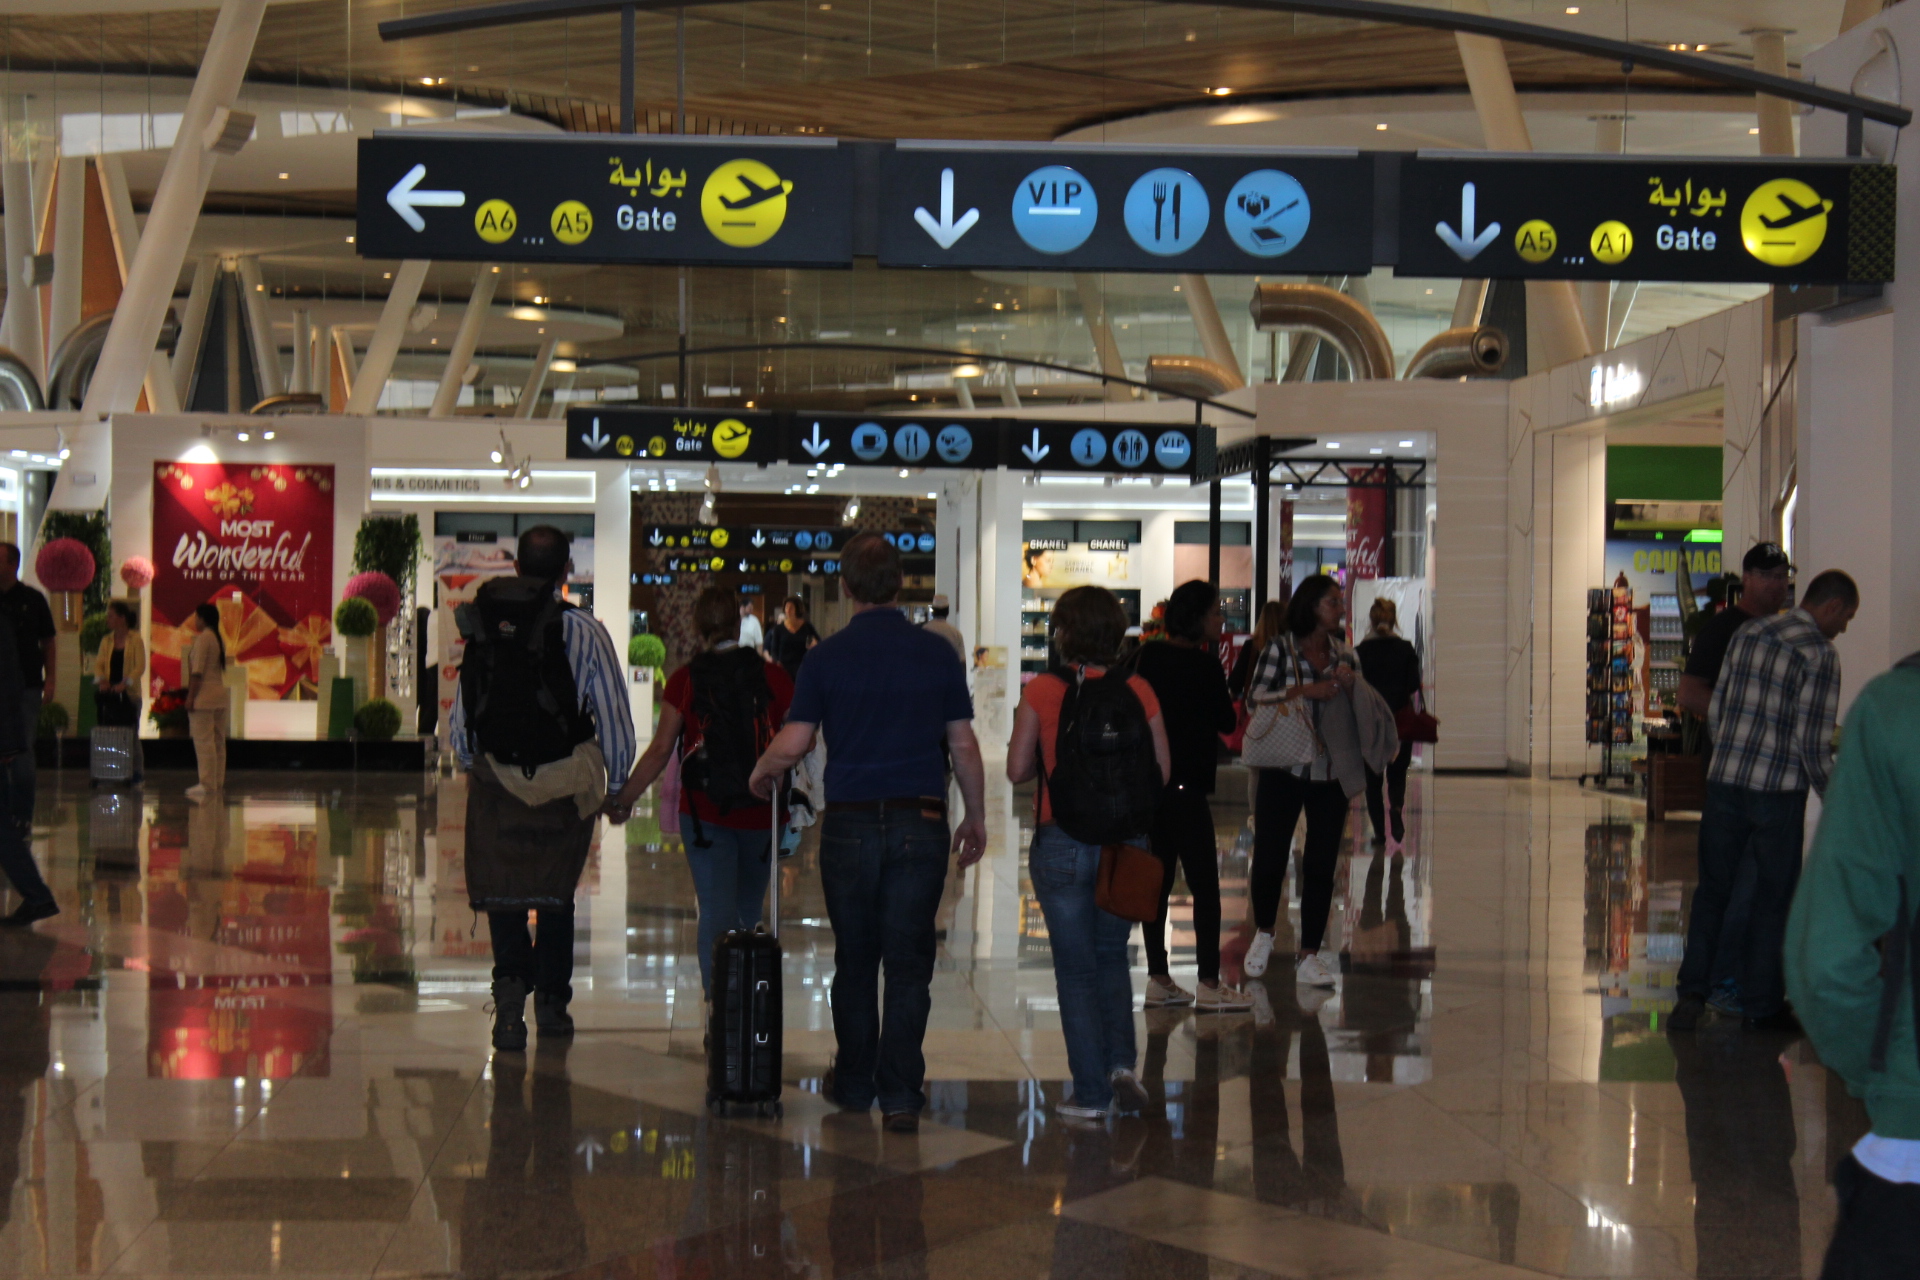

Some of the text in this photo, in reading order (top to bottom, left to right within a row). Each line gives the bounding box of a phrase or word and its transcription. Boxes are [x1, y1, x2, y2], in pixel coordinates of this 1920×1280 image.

[608, 157, 687, 198] بوابة
[1028, 180, 1082, 206] VIP
[1648, 176, 1727, 217] بوابة
[479, 210, 514, 233] A6
[556, 211, 590, 235] A5
[616, 205, 677, 232] Gate
[1519, 229, 1553, 253] A5
[1596, 231, 1628, 255] A1
[1656, 224, 1716, 252] Gate
[675, 437, 703, 451] Gate
[1162, 437, 1184, 449] VIP
[396, 478, 405, 489] &
[408, 478, 480, 491] COSMETICS
[220, 519, 275, 538] MOST
[172, 529, 312, 572] Wonderful
[1029, 539, 1067, 550] CHANEL
[1090, 539, 1127, 550] CHANEL
[182, 569, 305, 582] TIME OF THE YEAR
